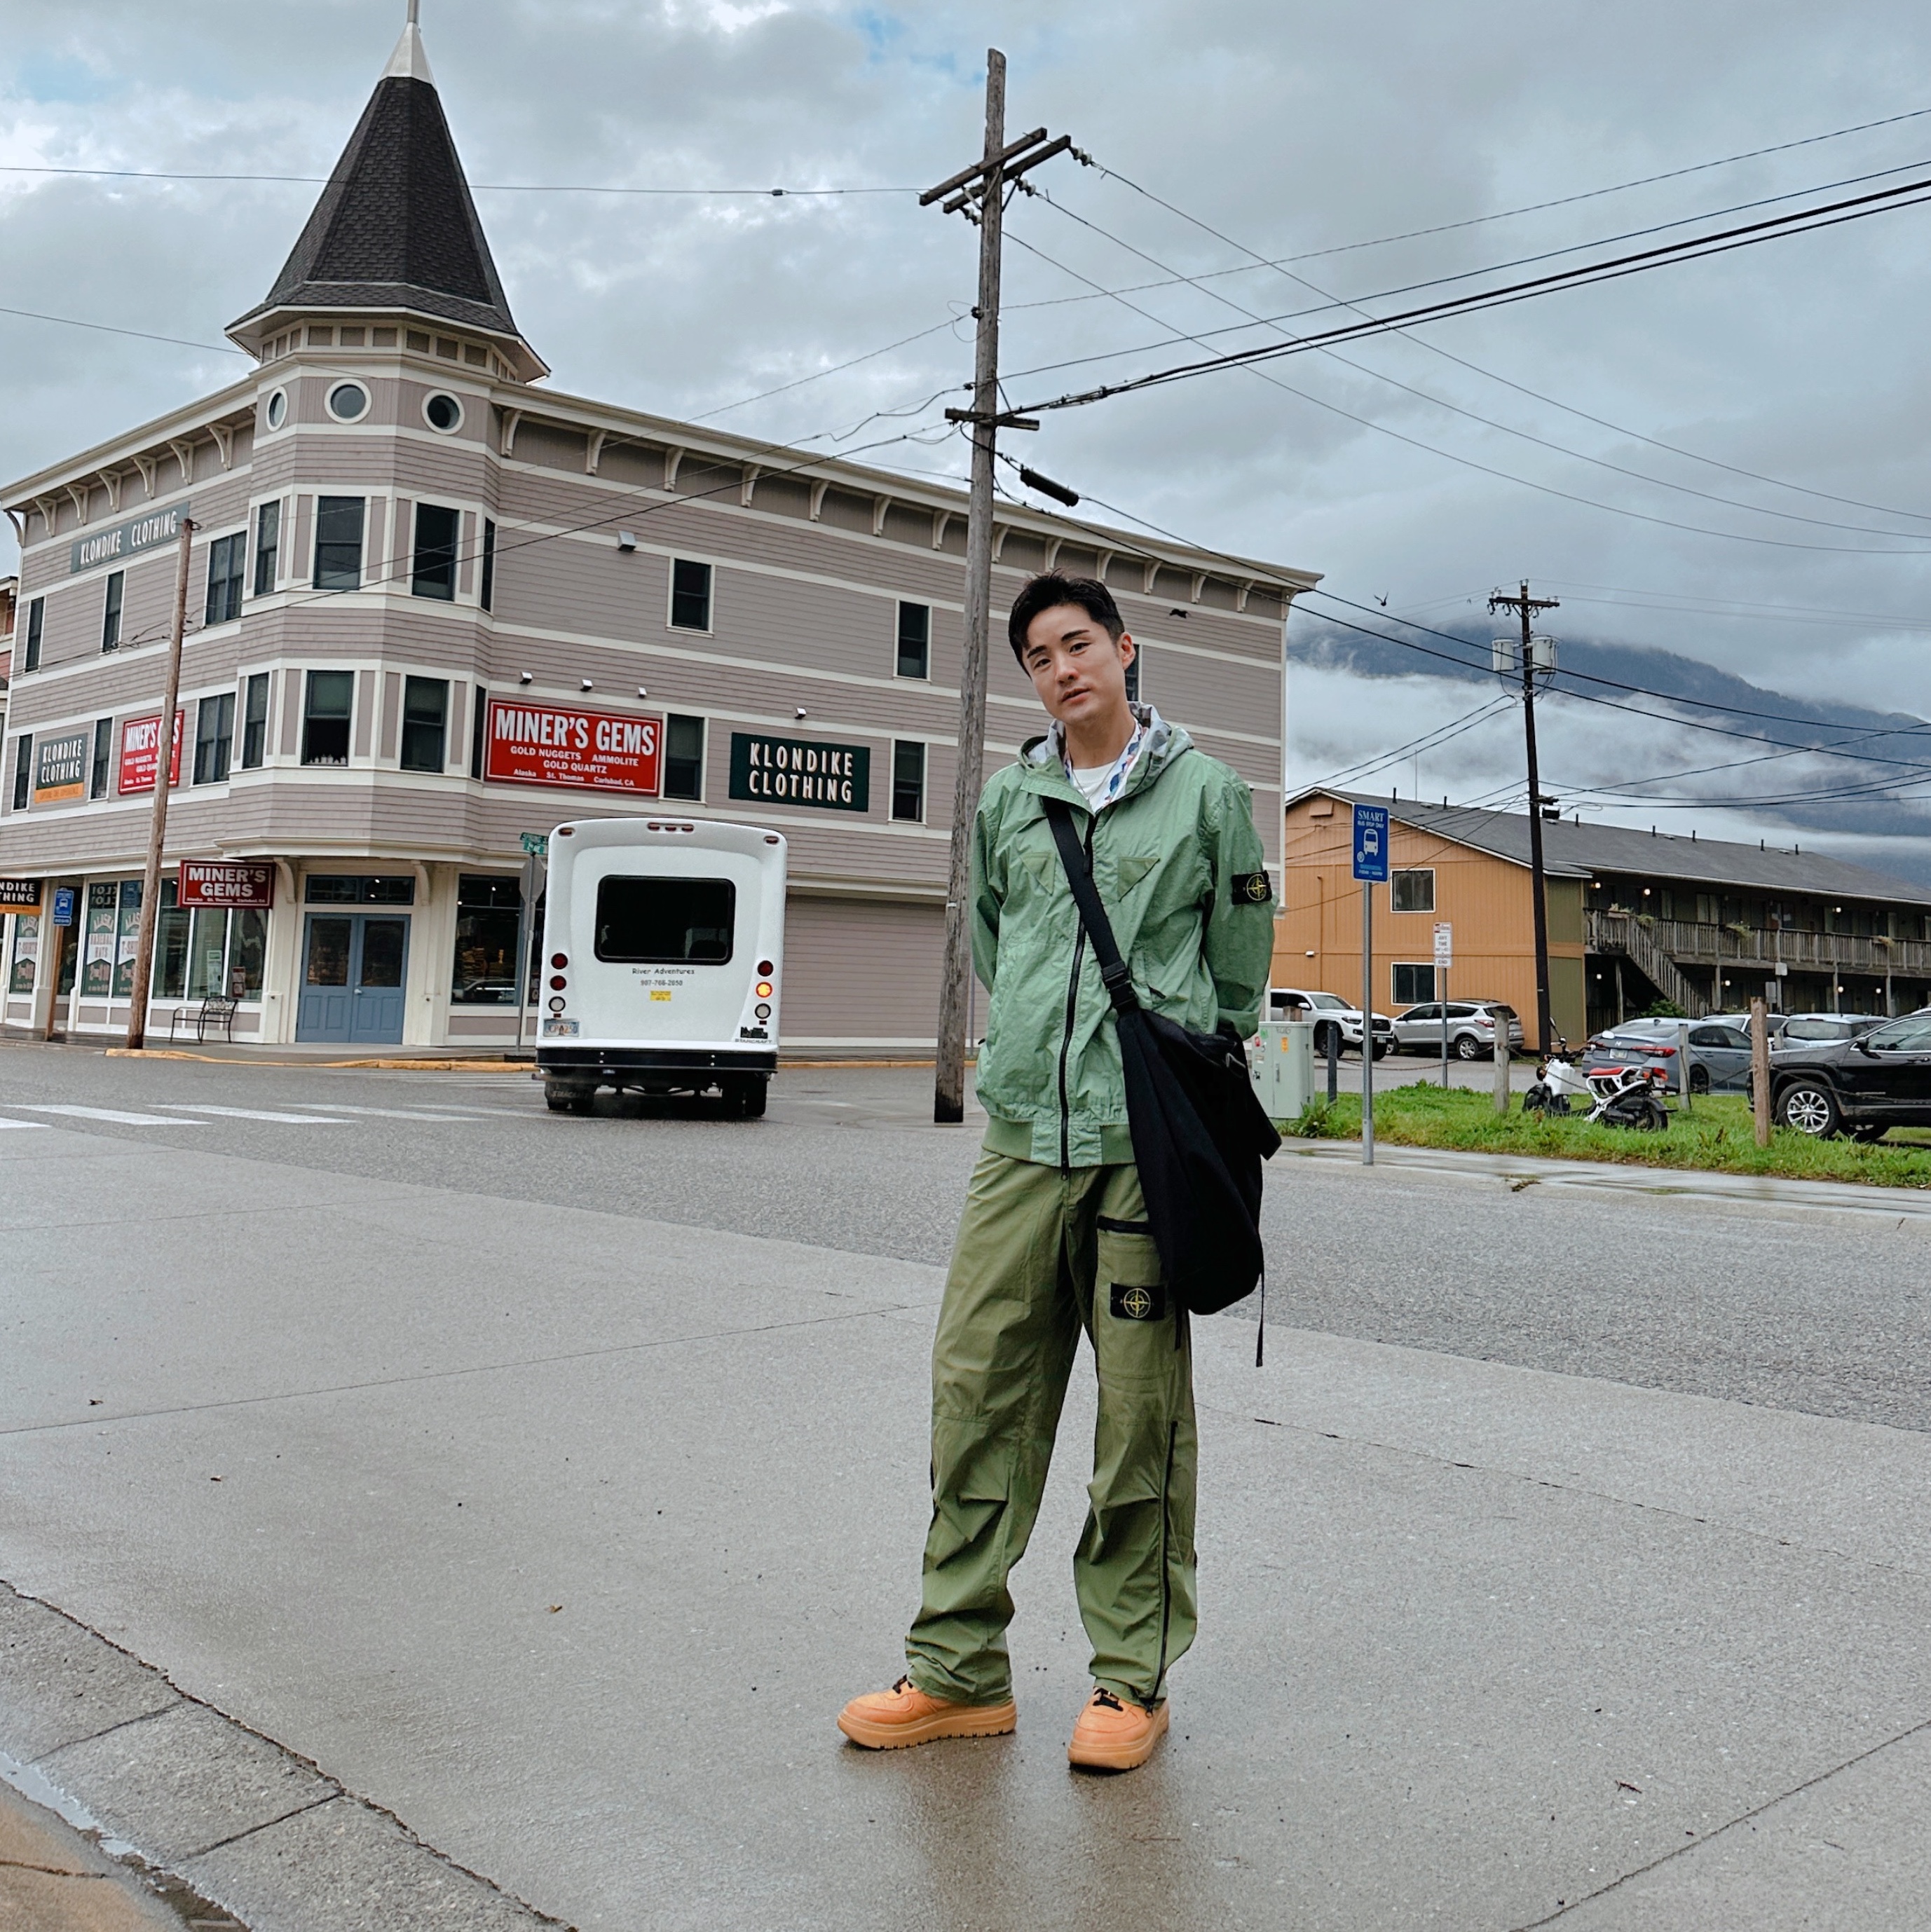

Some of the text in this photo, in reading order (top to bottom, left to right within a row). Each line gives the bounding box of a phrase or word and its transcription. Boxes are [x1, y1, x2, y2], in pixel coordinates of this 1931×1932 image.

[80, 511, 177, 564] KLONDIKE CLOTHING
[495, 708, 655, 756] MINER'S GEMS
[43, 739, 82, 763] KLONDIKE
[510, 746, 639, 766] GOLD NUGGETS AMMOLITE
[750, 742, 853, 776] KLONDIKE
[41, 760, 81, 783] CLOTHING
[514, 769, 537, 778] Alaska
[559, 773, 585, 781] Thomas
[543, 760, 607, 774] GOLD QUARTZ
[749, 770, 852, 803] CLOTHING
[1358, 810, 1384, 822] SMART
[189, 867, 266, 883] MINER'S
[0, 892, 35, 903] HING
[200, 882, 253, 897] GEMS
